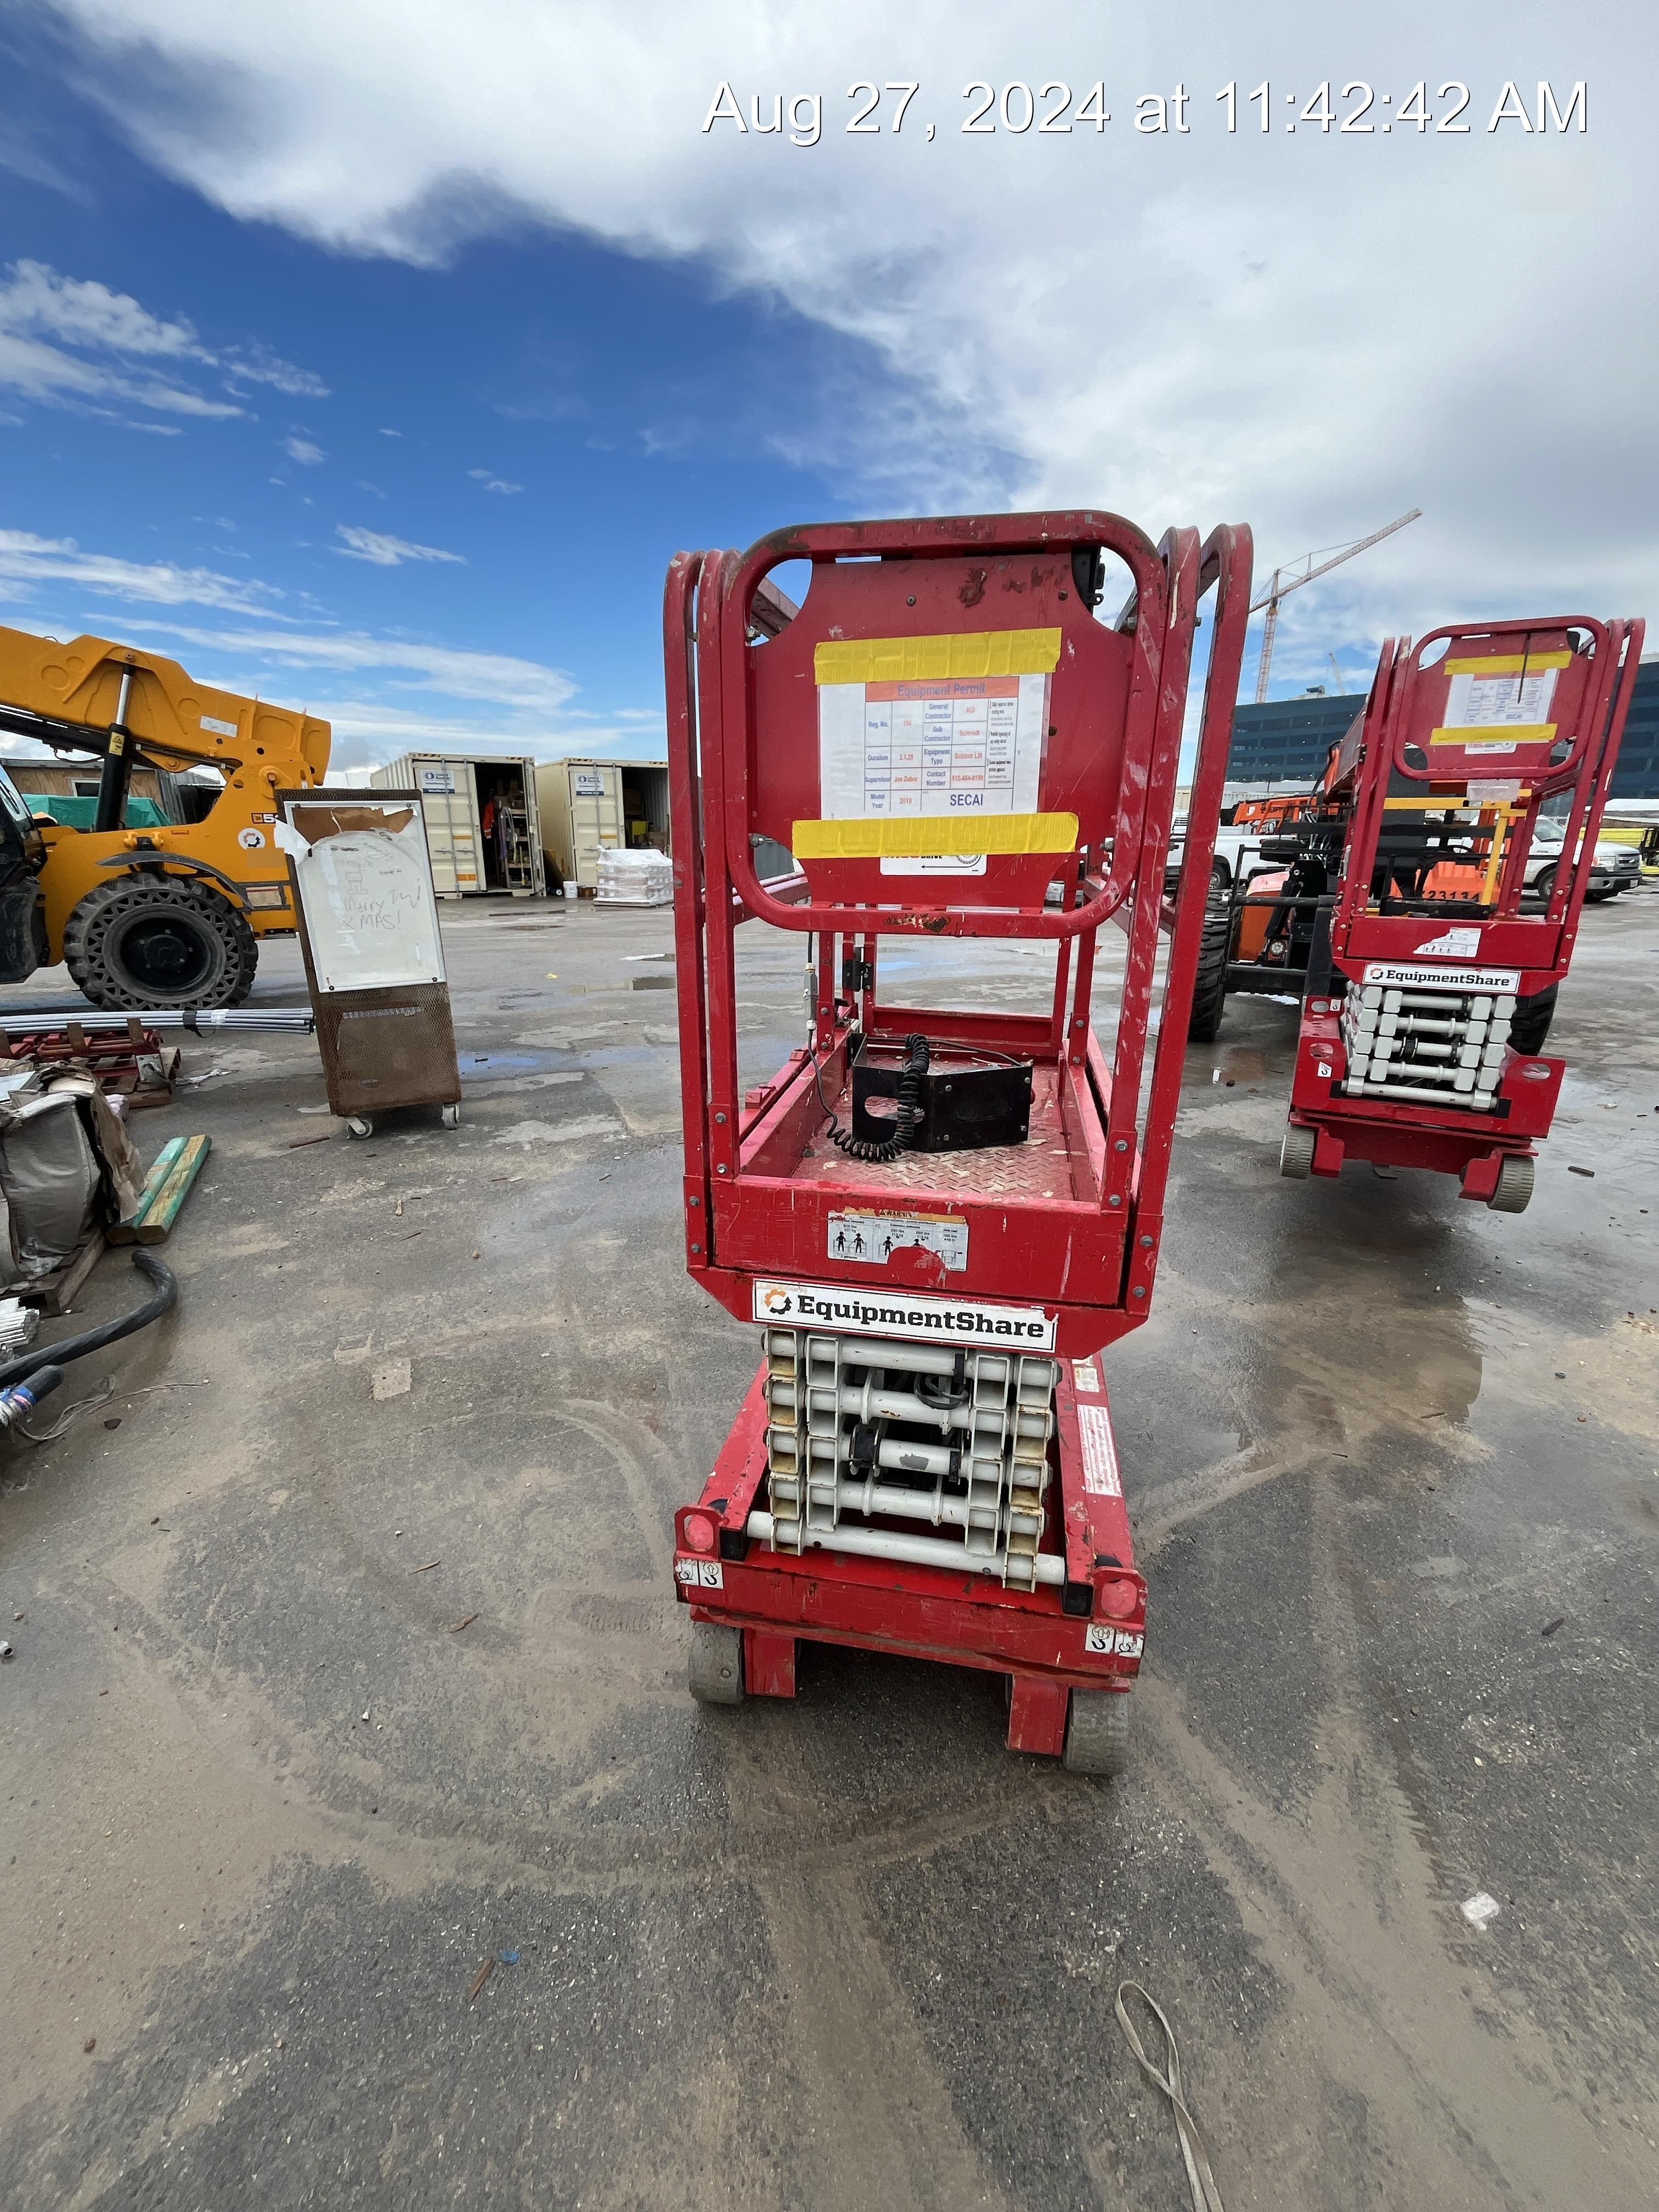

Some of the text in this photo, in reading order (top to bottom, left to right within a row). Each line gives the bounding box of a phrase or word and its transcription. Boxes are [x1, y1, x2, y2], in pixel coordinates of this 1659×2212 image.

[898, 682, 985, 698] Equipment Permit
[924, 748, 950, 757] Equipment
[930, 758, 943, 766] Type
[950, 793, 984, 806] SECAI
[1385, 969, 1510, 986] EquipmentShare
[797, 1294, 1045, 1338] EquipmentShare
